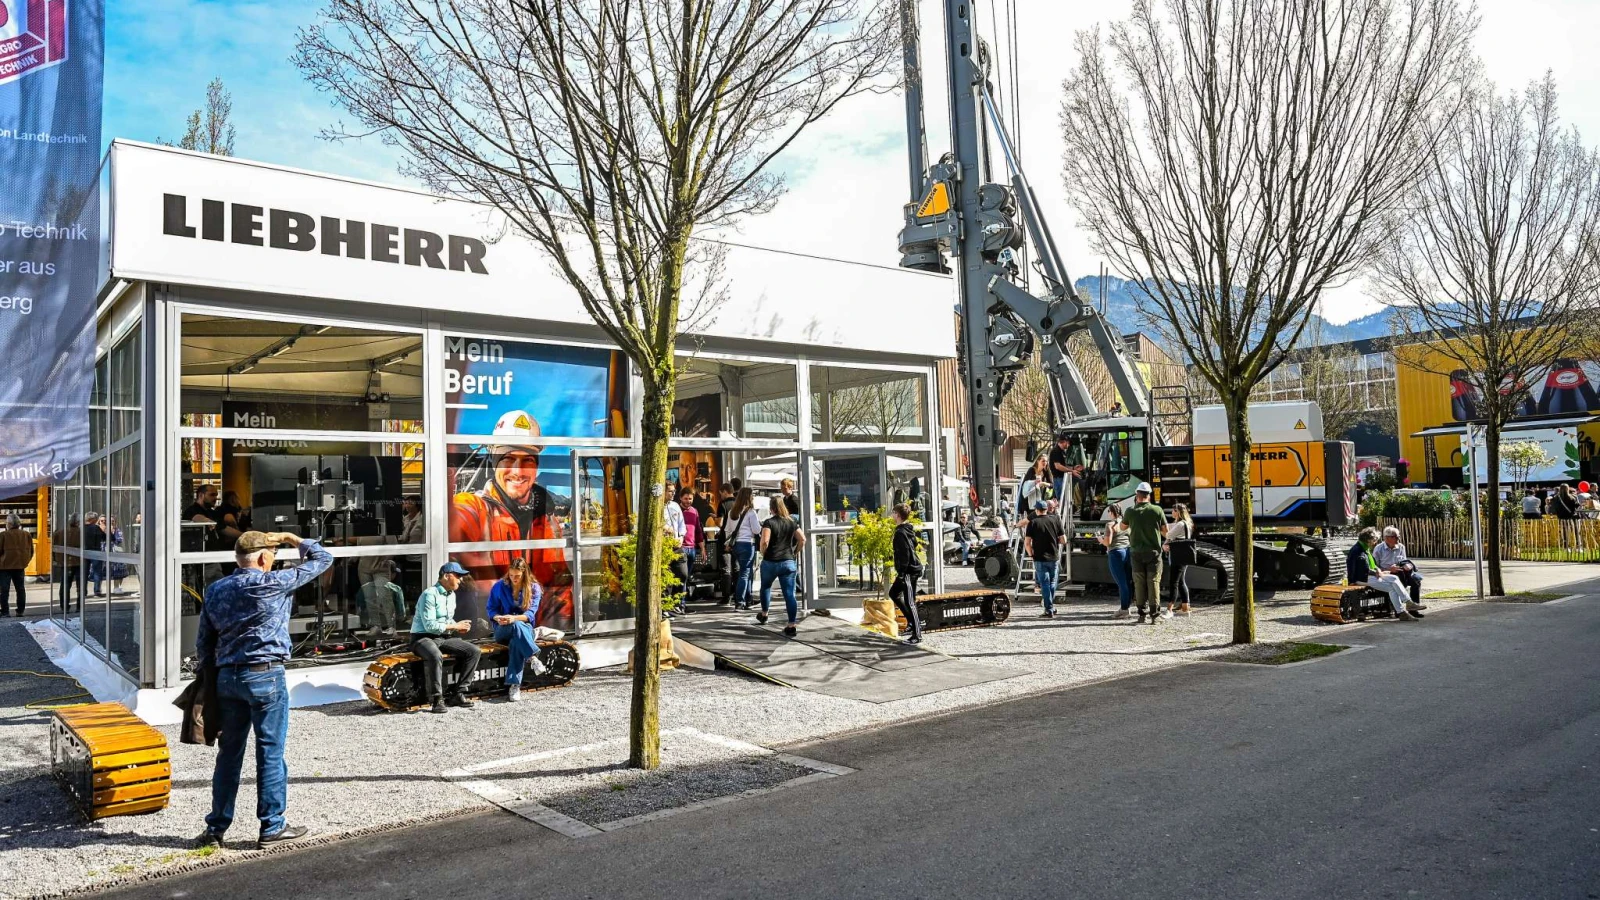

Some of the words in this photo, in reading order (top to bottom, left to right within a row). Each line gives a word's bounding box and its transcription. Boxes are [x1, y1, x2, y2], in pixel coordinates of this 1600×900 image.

[0, 40, 22, 55] GRO
[13, 129, 88, 144] Landtechnik
[10, 220, 88, 240] Technik
[163, 193, 489, 275] LIEBHERR
[18, 261, 56, 276] aus
[444, 336, 504, 363] Mein
[444, 368, 513, 396] Beruf
[233, 412, 276, 428] Mein
[1221, 451, 1289, 462] LIHERR
[942, 606, 981, 618] LIEBHERR
[447, 666, 509, 685] LIBHER
